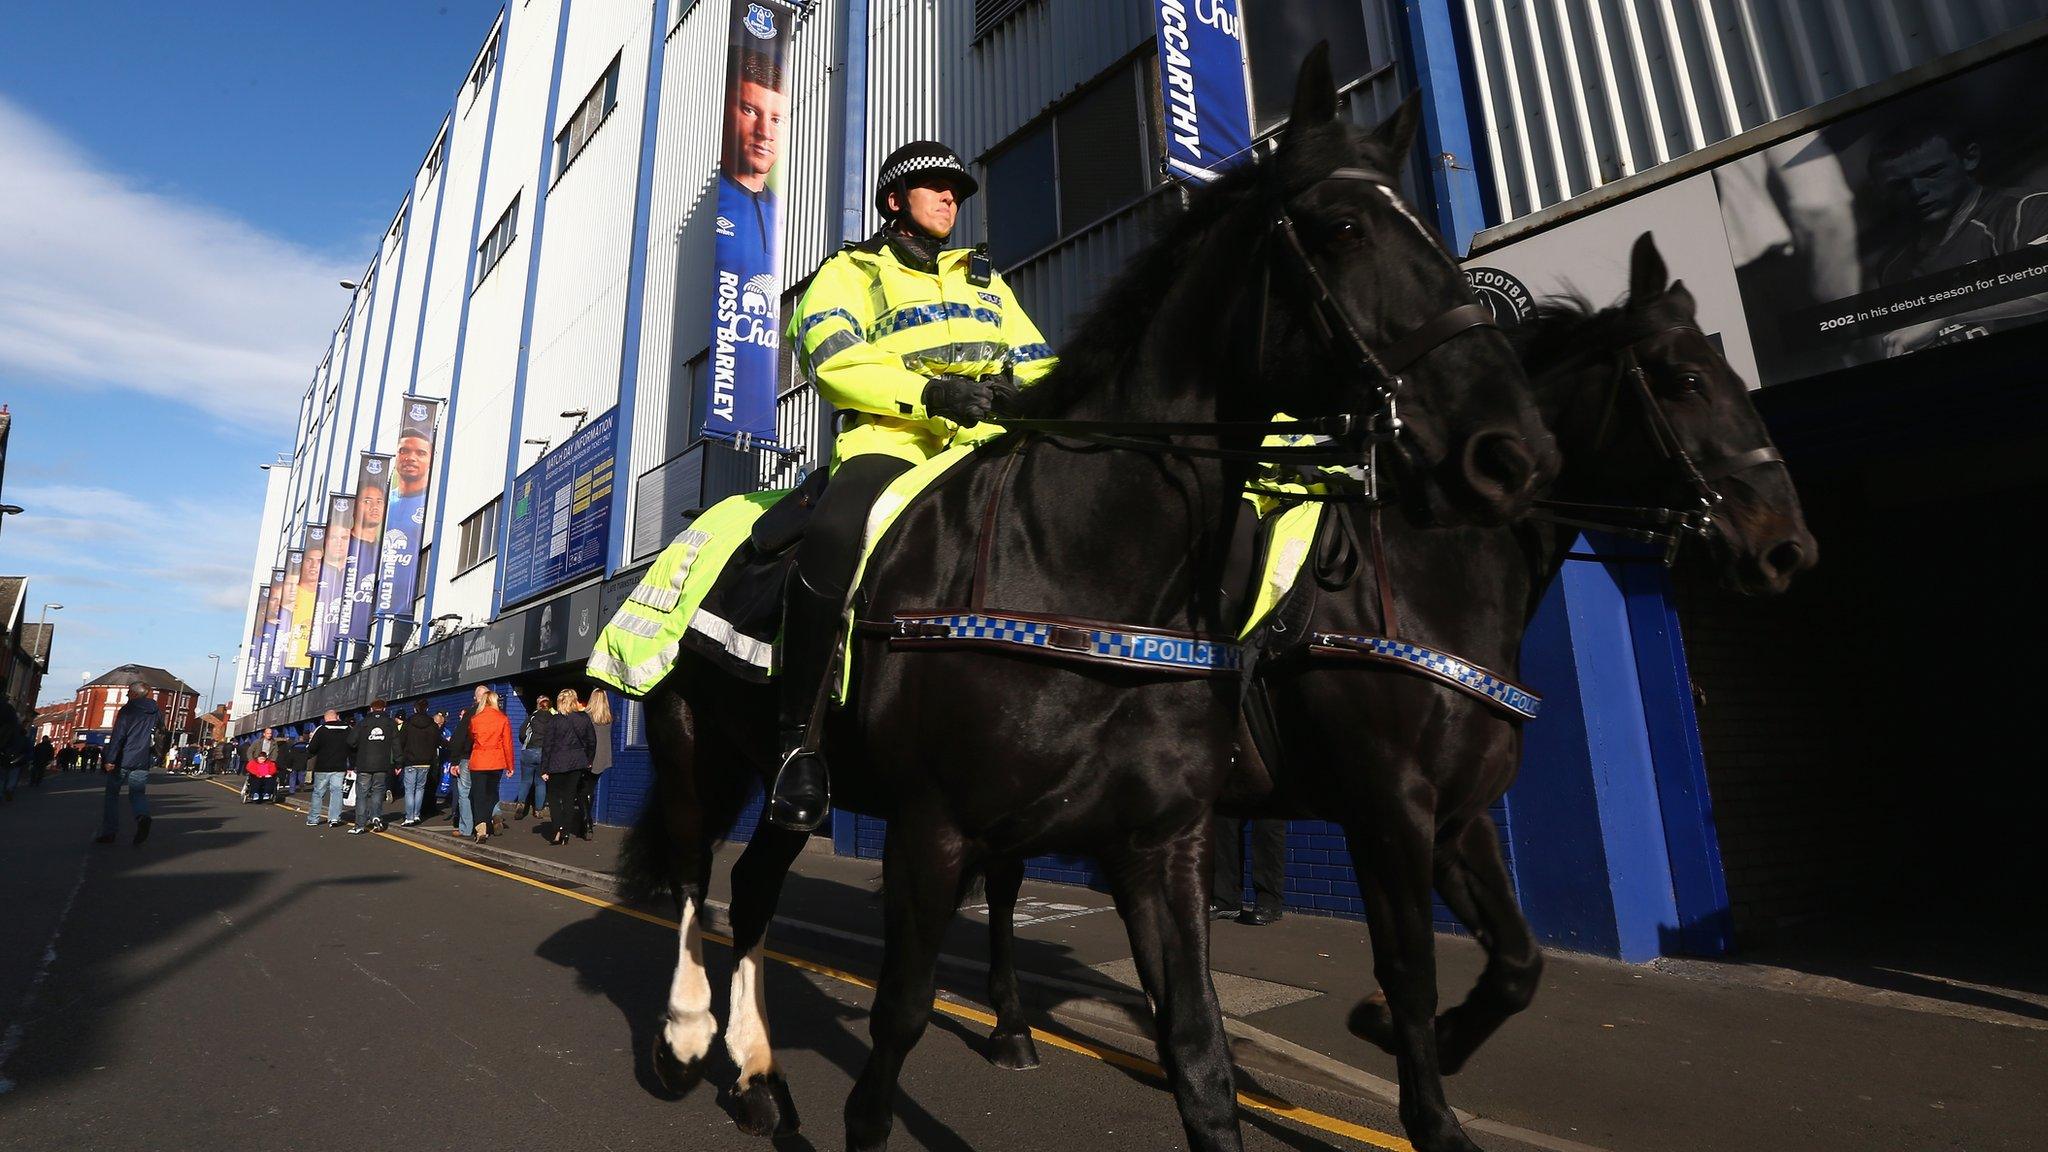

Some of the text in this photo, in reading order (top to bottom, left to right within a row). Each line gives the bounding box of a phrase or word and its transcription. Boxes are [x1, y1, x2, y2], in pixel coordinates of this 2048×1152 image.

[1820, 315, 1856, 331] 2002
[1857, 312, 1869, 321] In
[1870, 307, 1889, 318] his
[1890, 296, 1926, 313] debut
[1928, 285, 1974, 303] season
[1975, 279, 1995, 291] for
[713, 270, 739, 422] ROSS BARKLEY
[546, 451, 563, 471] MATCH
[563, 442, 575, 460] DAY
[574, 415, 613, 452] INFORMATION
